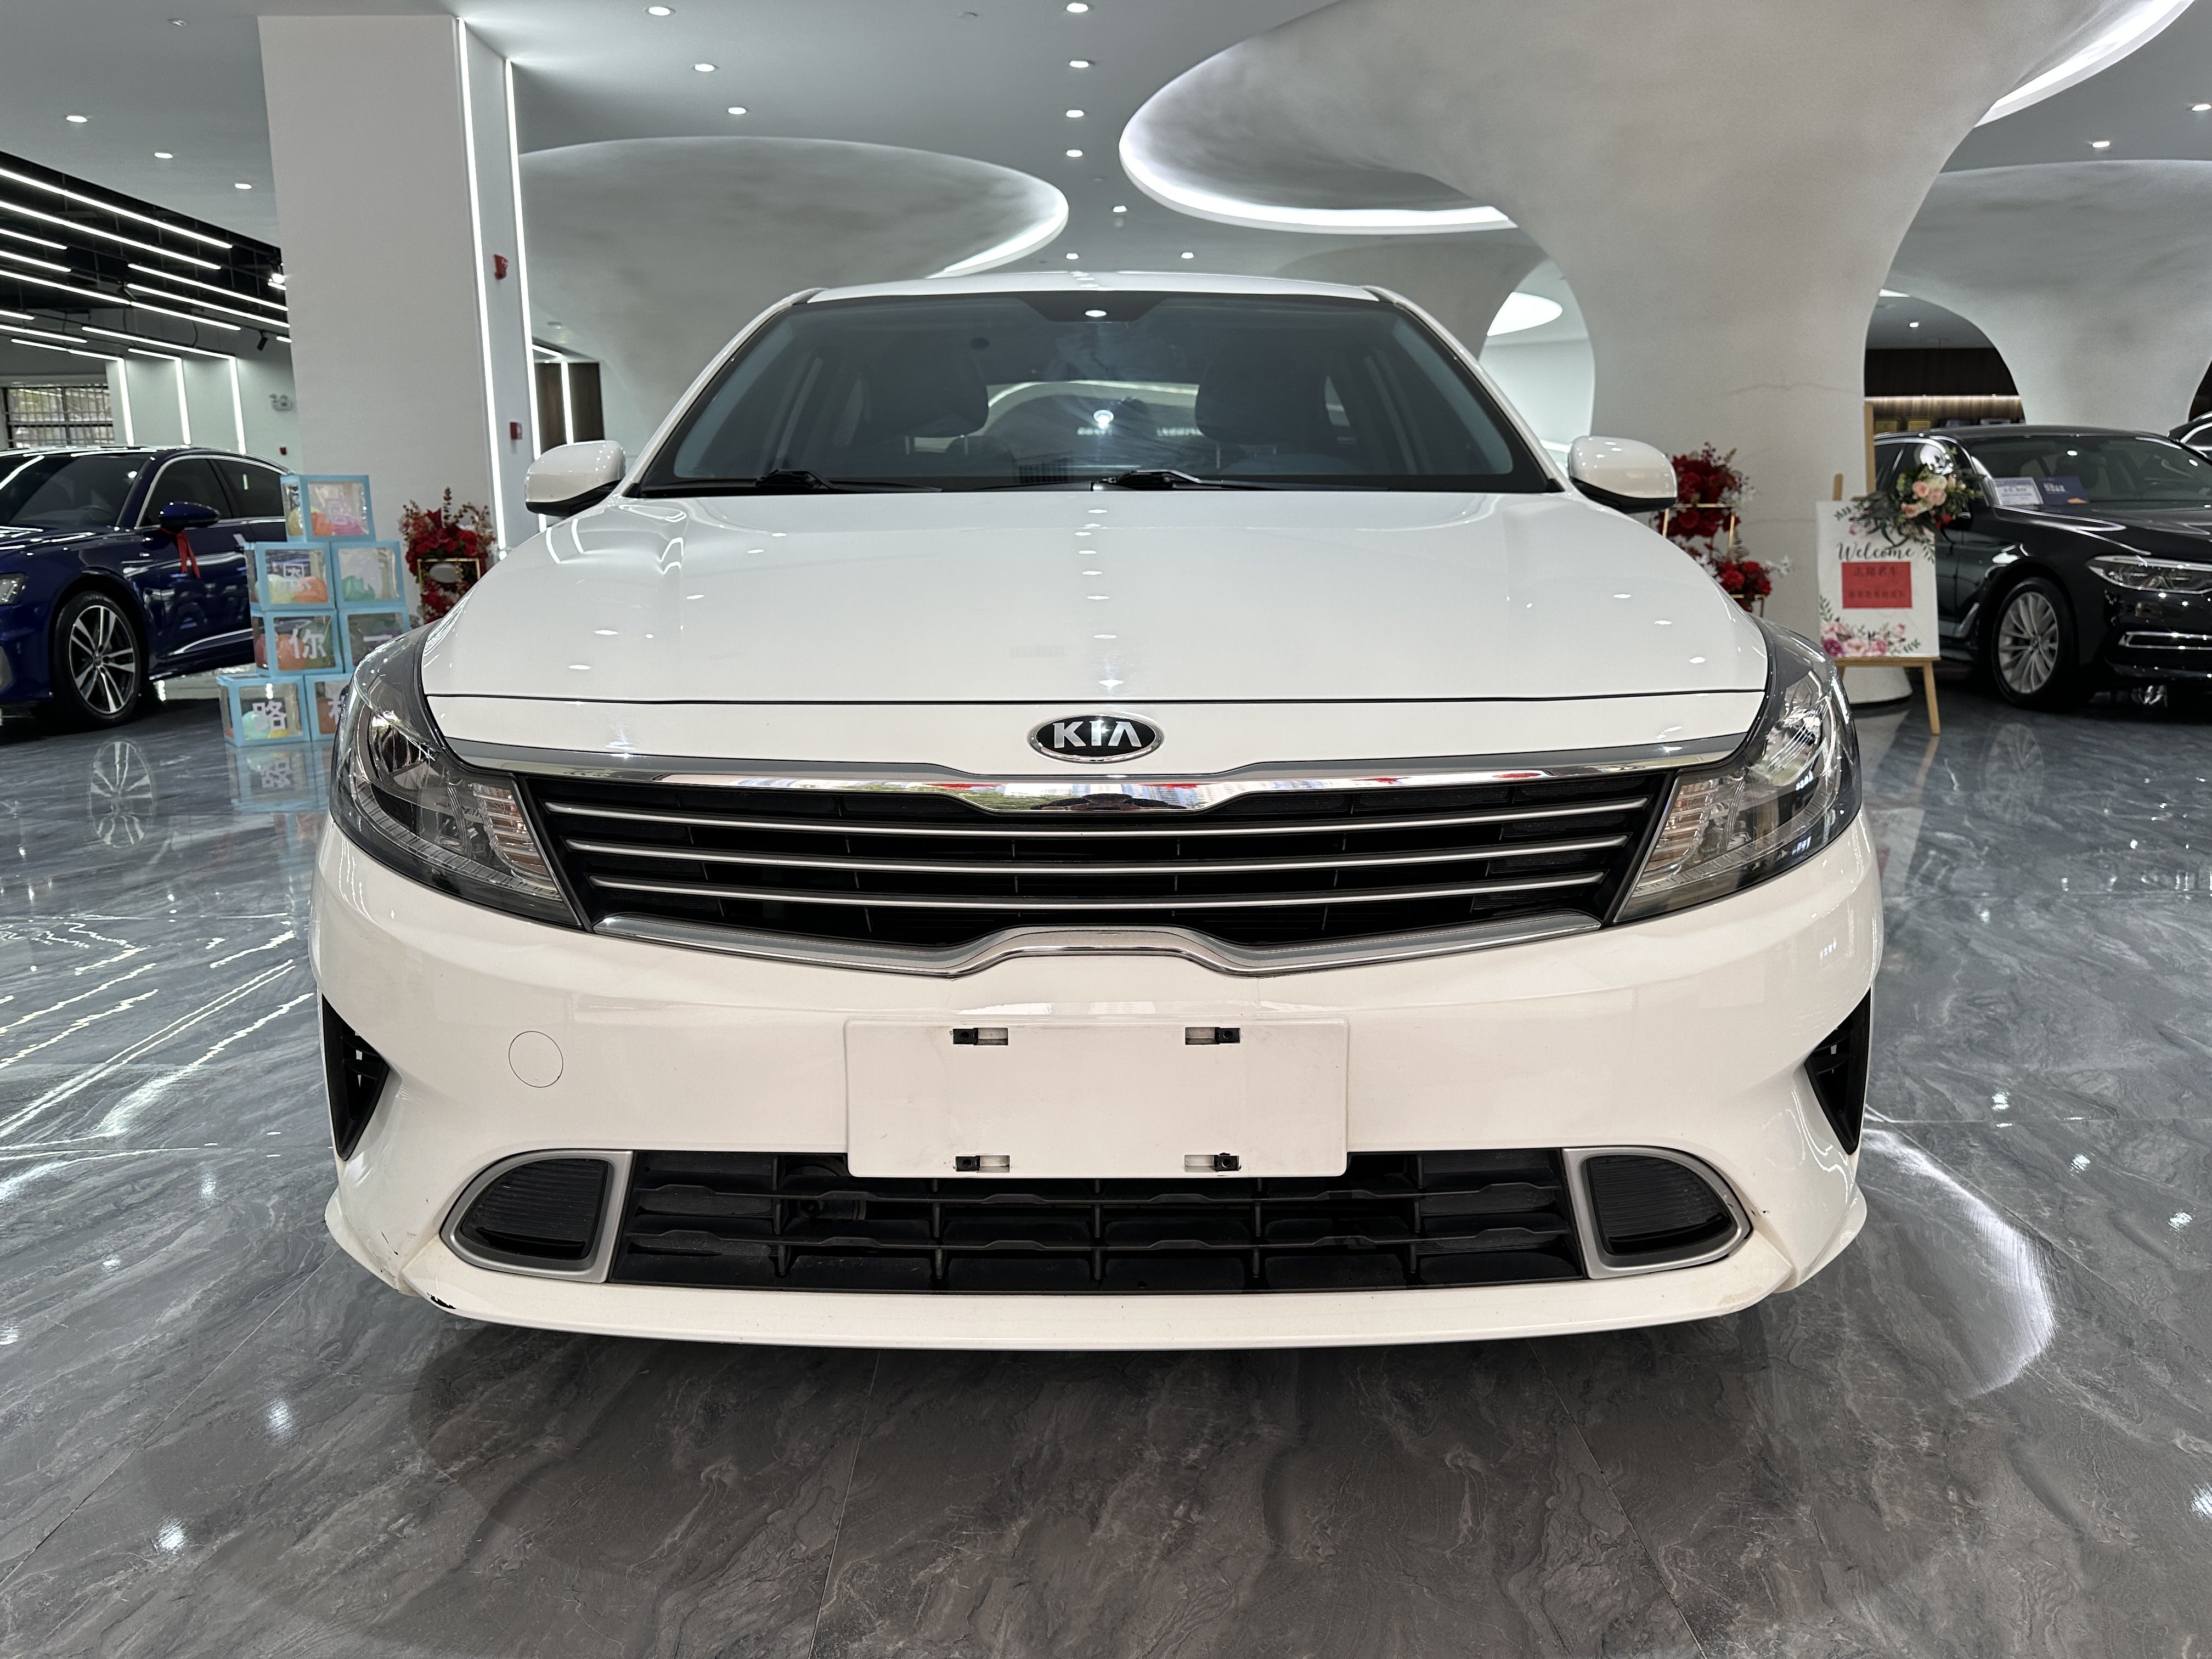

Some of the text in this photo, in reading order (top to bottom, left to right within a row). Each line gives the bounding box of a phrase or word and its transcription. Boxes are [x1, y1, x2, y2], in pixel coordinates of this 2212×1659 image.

[1836, 541, 1915, 562] Welcome
[288, 628, 327, 659] 你
[252, 701, 287, 732] 路
[1052, 720, 1142, 749] KIA
